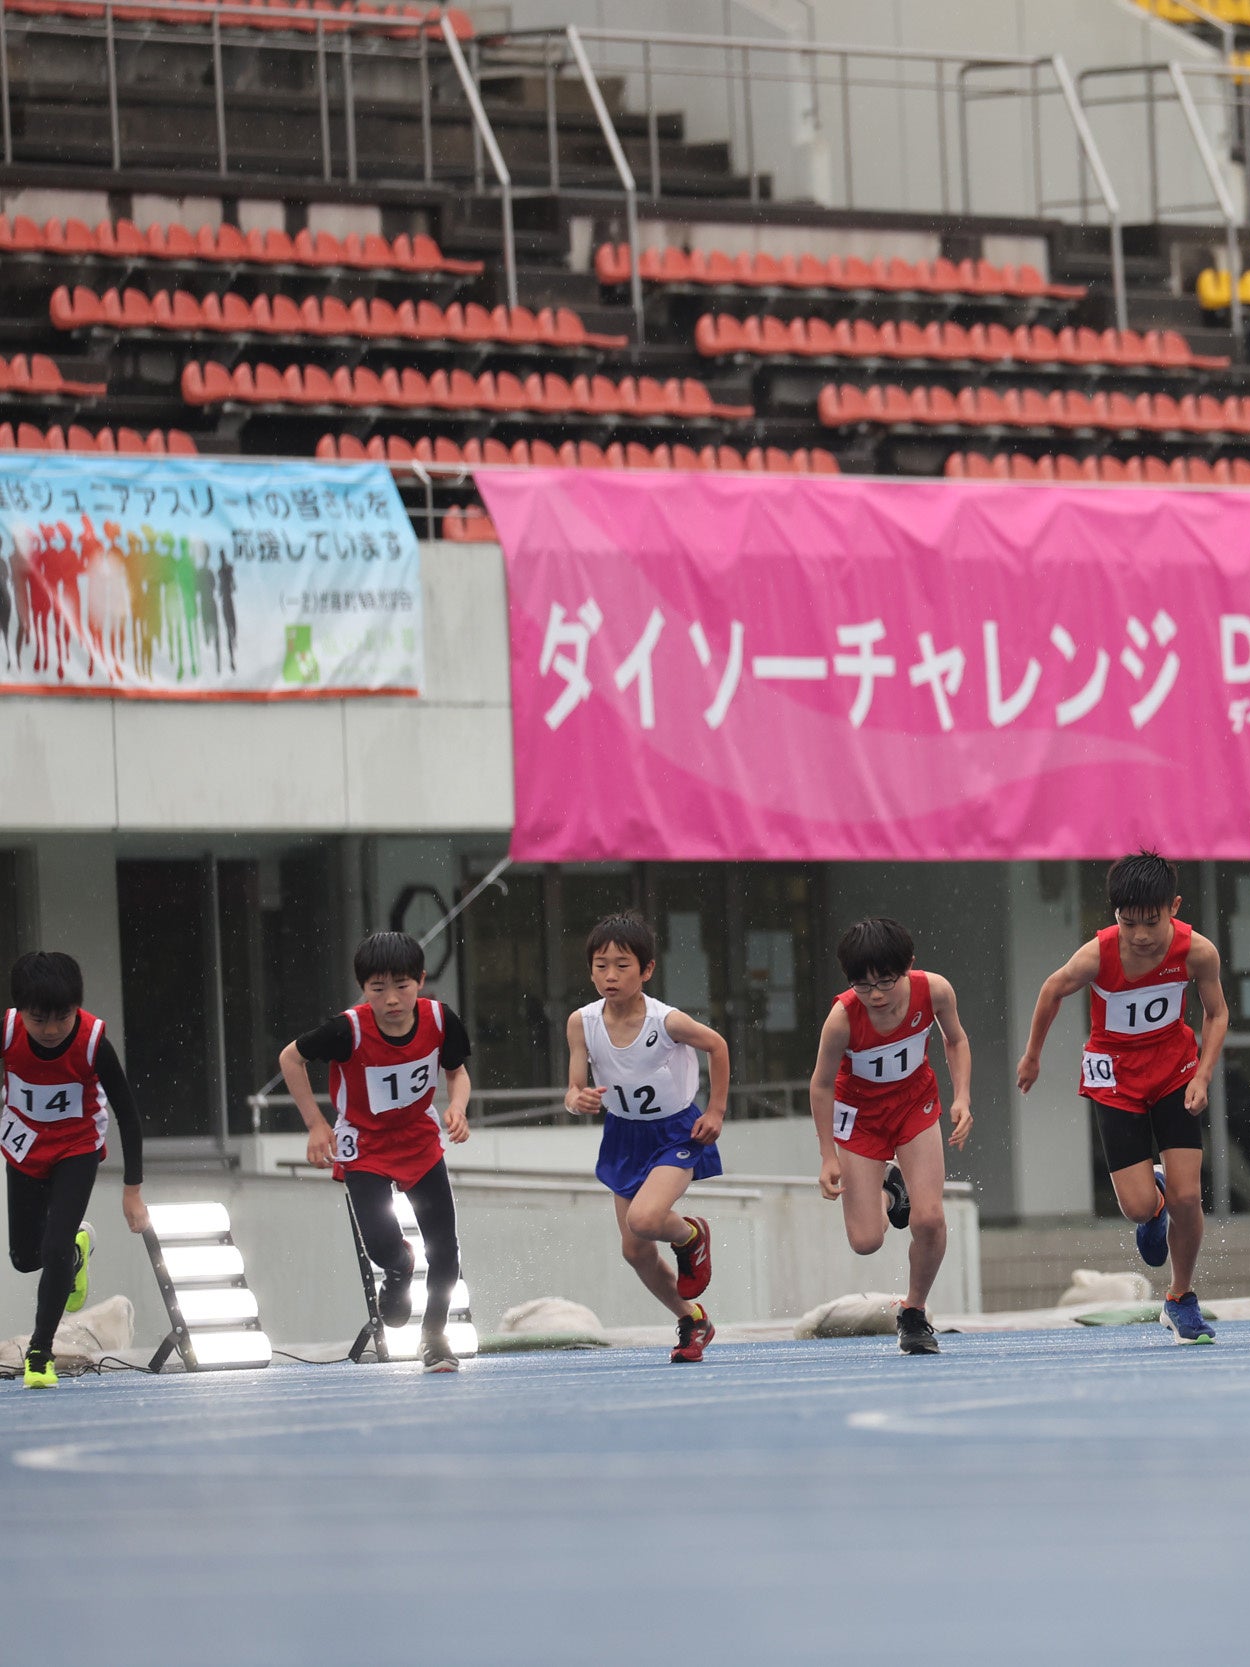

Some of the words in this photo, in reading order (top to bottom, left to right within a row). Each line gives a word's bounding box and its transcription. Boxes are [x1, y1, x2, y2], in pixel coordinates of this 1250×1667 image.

[539, 597, 1179, 730] ダイソーチャレンジ
[1126, 997, 1169, 1027] 10
[868, 1047, 908, 1078] 11
[1086, 1058, 1111, 1081] 10
[382, 1064, 429, 1100] 13
[21, 1089, 71, 1113] 14
[613, 1085, 662, 1115] 12
[2, 1120, 27, 1153] 14
